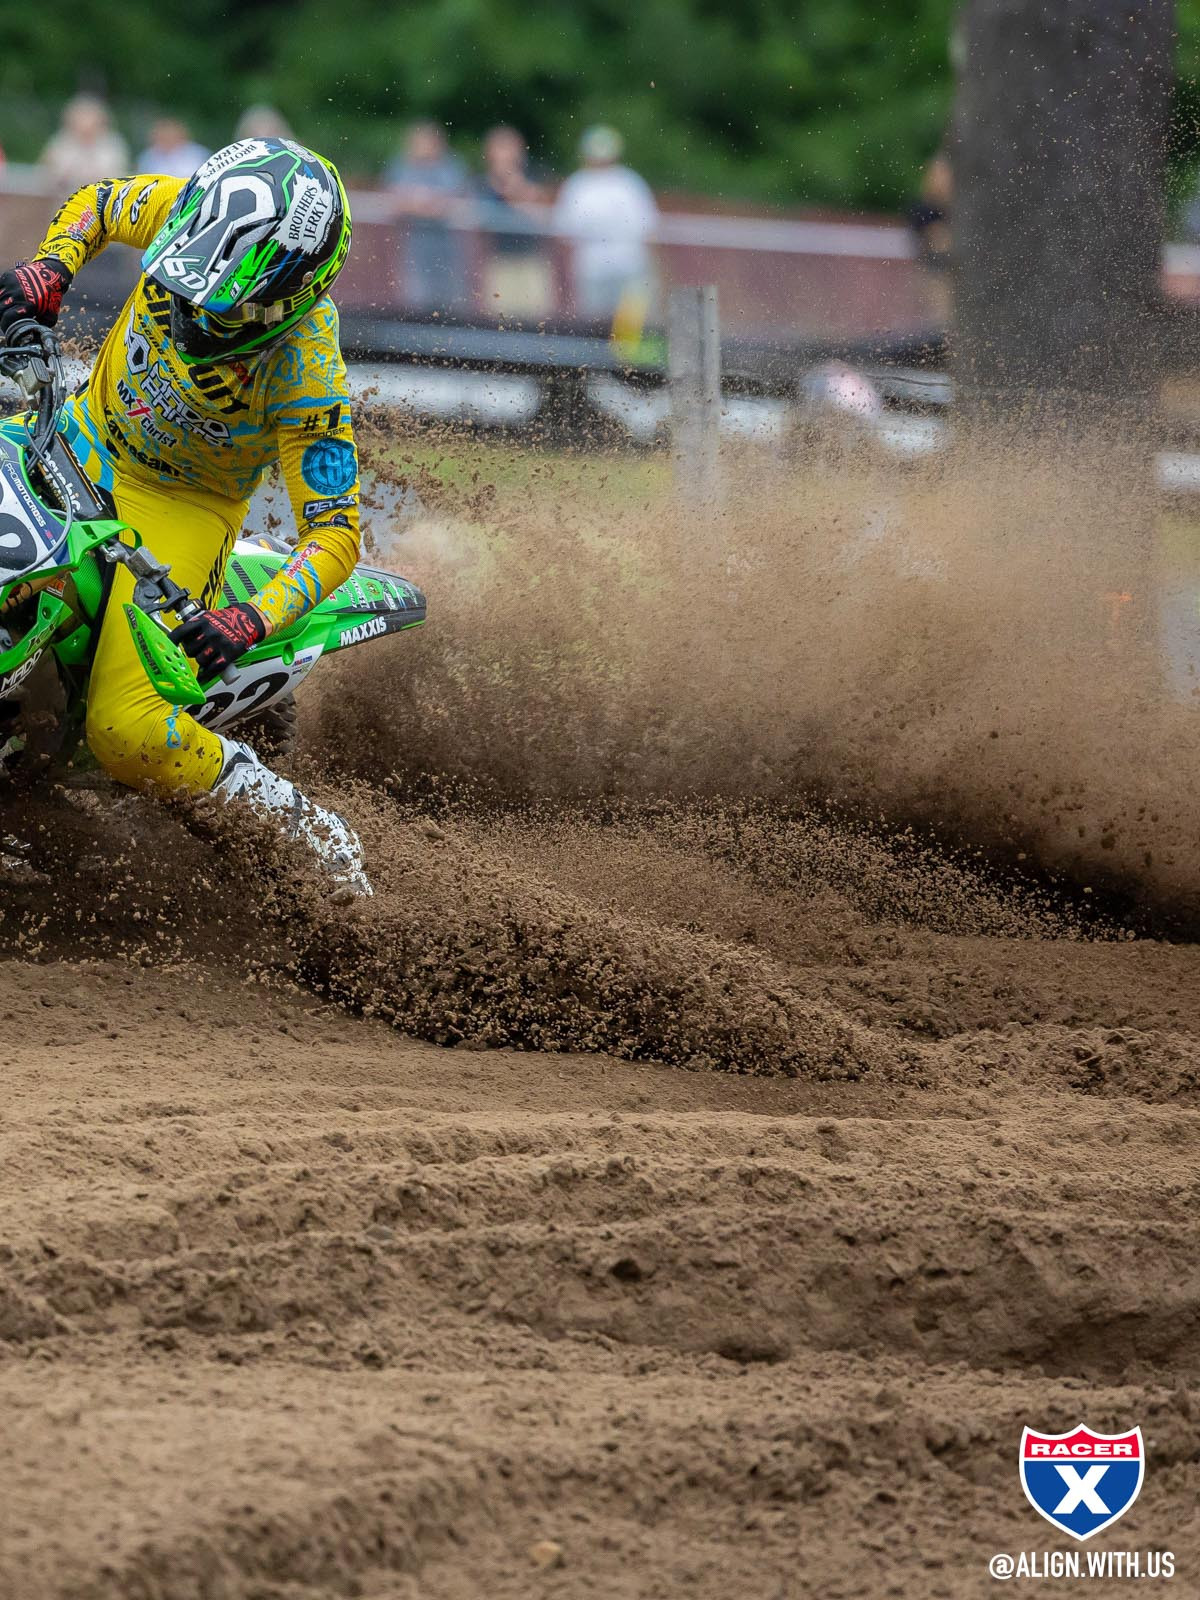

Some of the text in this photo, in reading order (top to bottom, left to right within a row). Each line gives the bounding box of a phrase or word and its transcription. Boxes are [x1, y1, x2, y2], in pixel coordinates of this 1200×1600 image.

[289, 185, 317, 240] BROTHERS
[303, 198, 328, 242] JERKY
[161, 256, 208, 291] 6D
[303, 403, 341, 431] #1
[340, 616, 387, 646] MAXXIS
[1, 649, 43, 691] MADD
